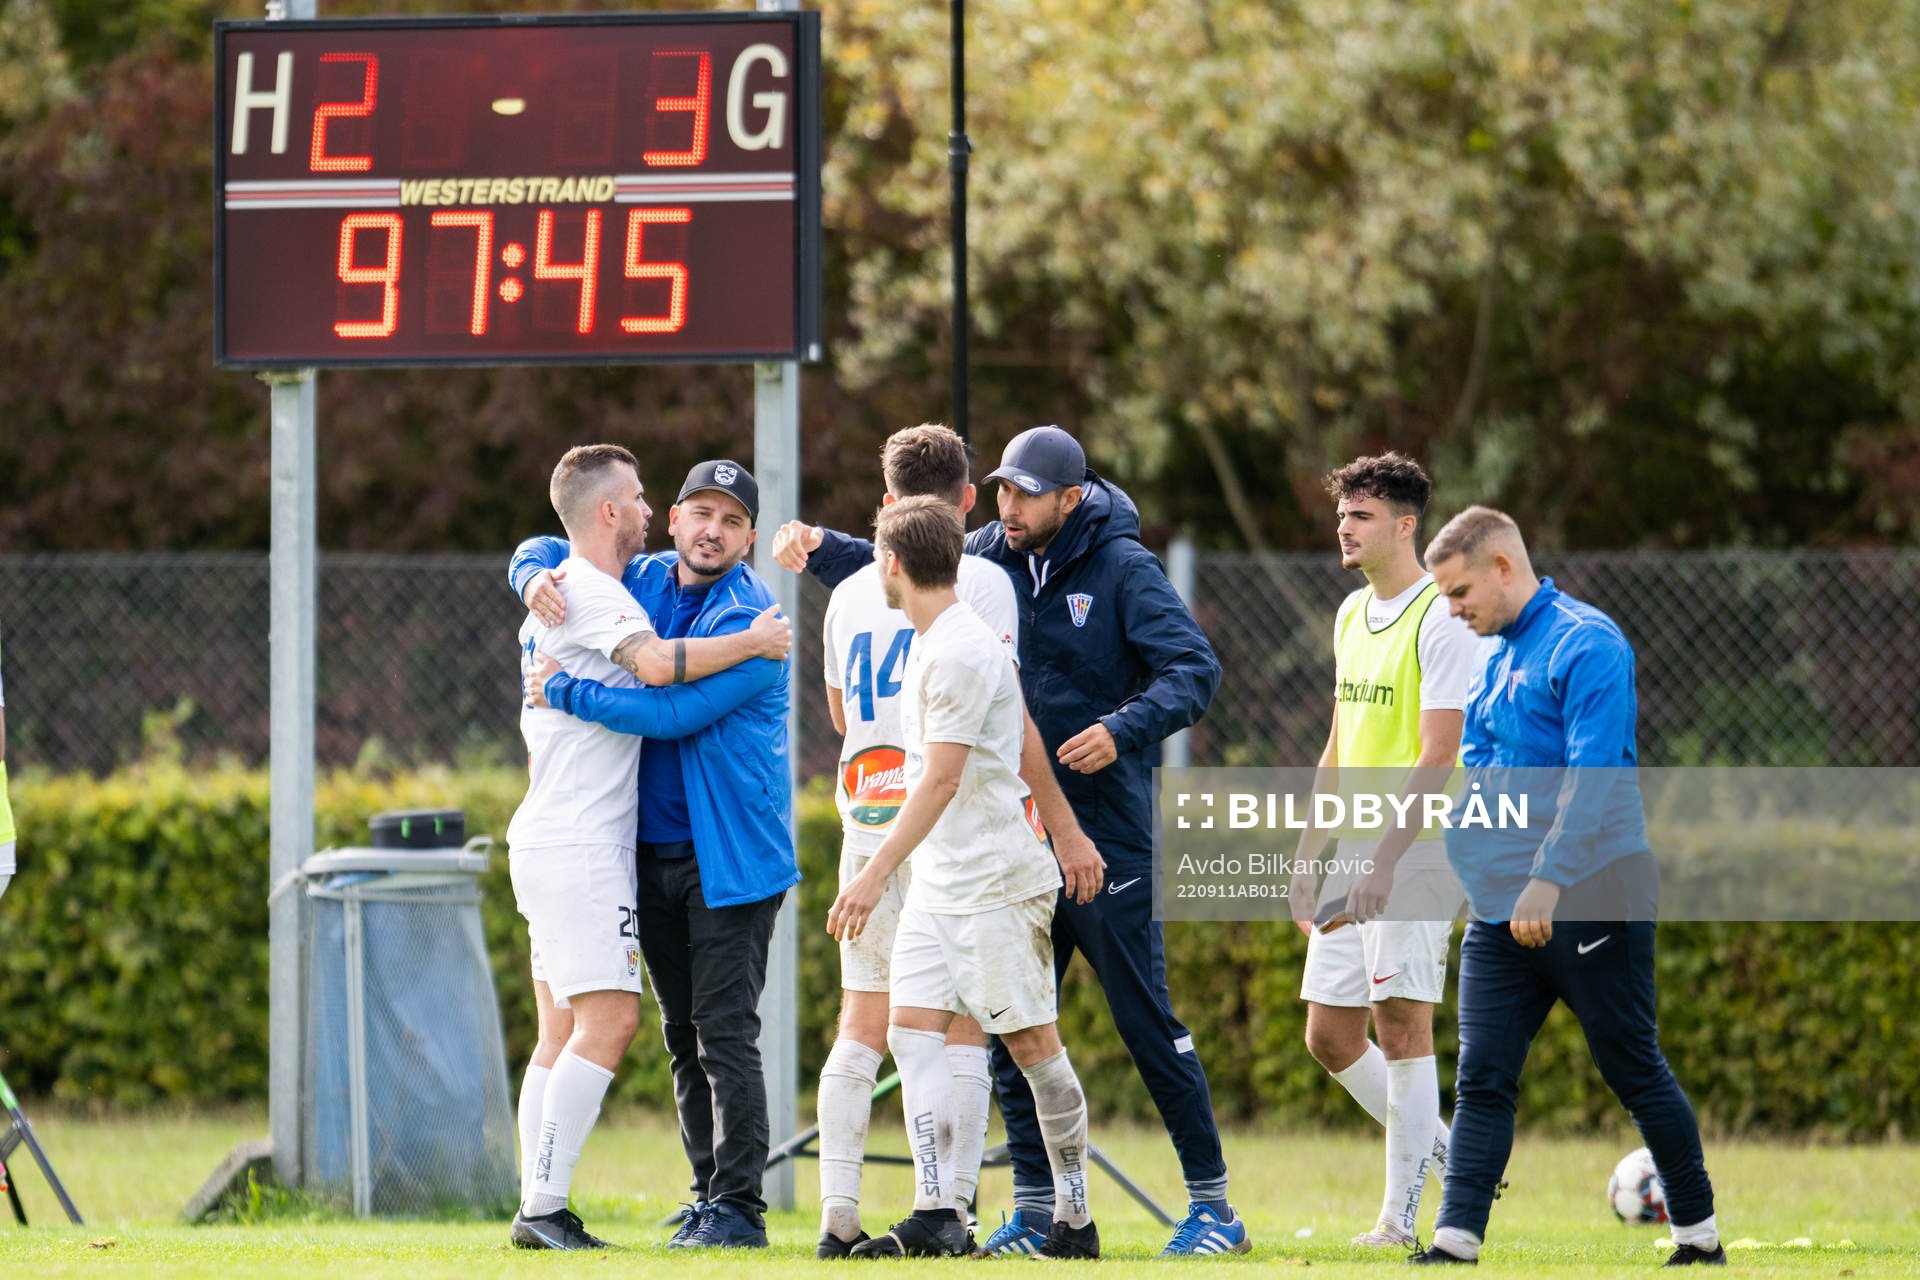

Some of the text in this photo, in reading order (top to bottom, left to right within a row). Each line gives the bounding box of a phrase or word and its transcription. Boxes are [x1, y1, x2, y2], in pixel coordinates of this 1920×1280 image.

[231, 51, 293, 155] H
[310, 51, 378, 172] 2
[642, 50, 712, 166] 3
[726, 43, 788, 151] G
[400, 176, 615, 206] WESTERSTRAND
[334, 208, 693, 338] 97:45
[846, 629, 914, 721] 44
[914, 1111, 941, 1198] stadium
[1059, 1145, 1087, 1215] stadium
